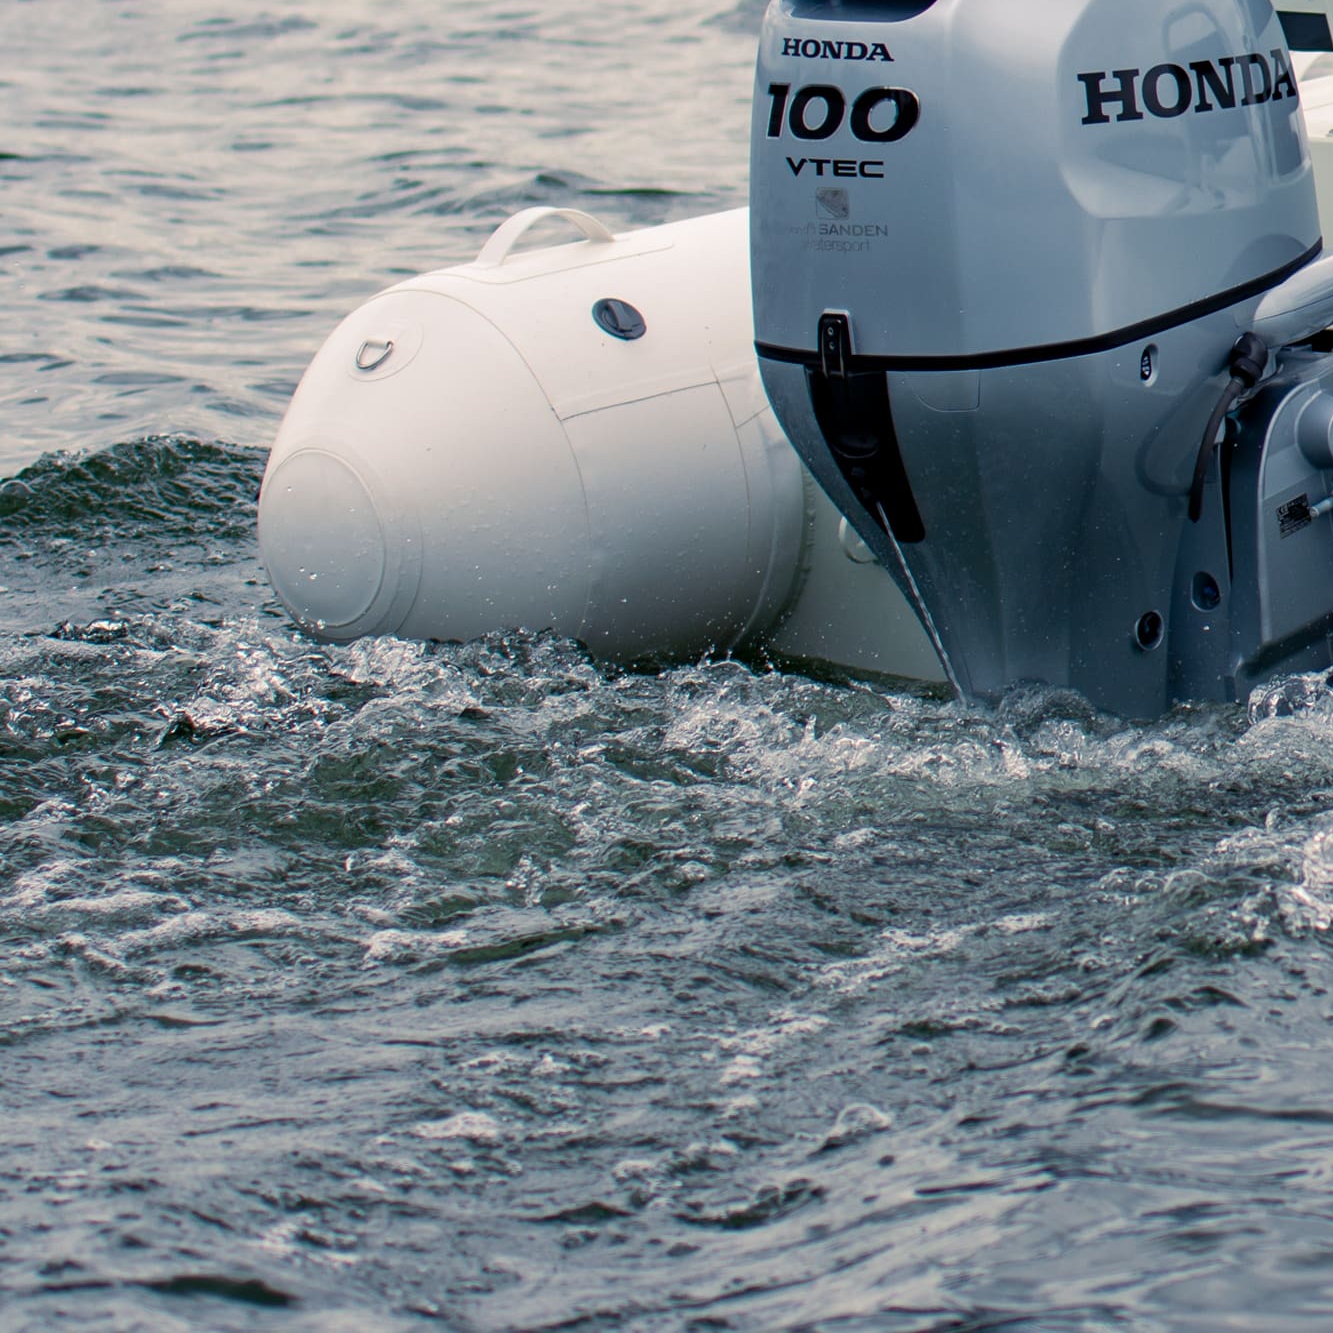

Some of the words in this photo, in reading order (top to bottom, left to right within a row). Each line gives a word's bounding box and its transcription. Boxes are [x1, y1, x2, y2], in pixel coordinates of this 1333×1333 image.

[781, 38, 895, 62] HONDA
[1077, 48, 1297, 125] HONDA
[766, 82, 920, 144] 100
[786, 156, 884, 178] VTEC
